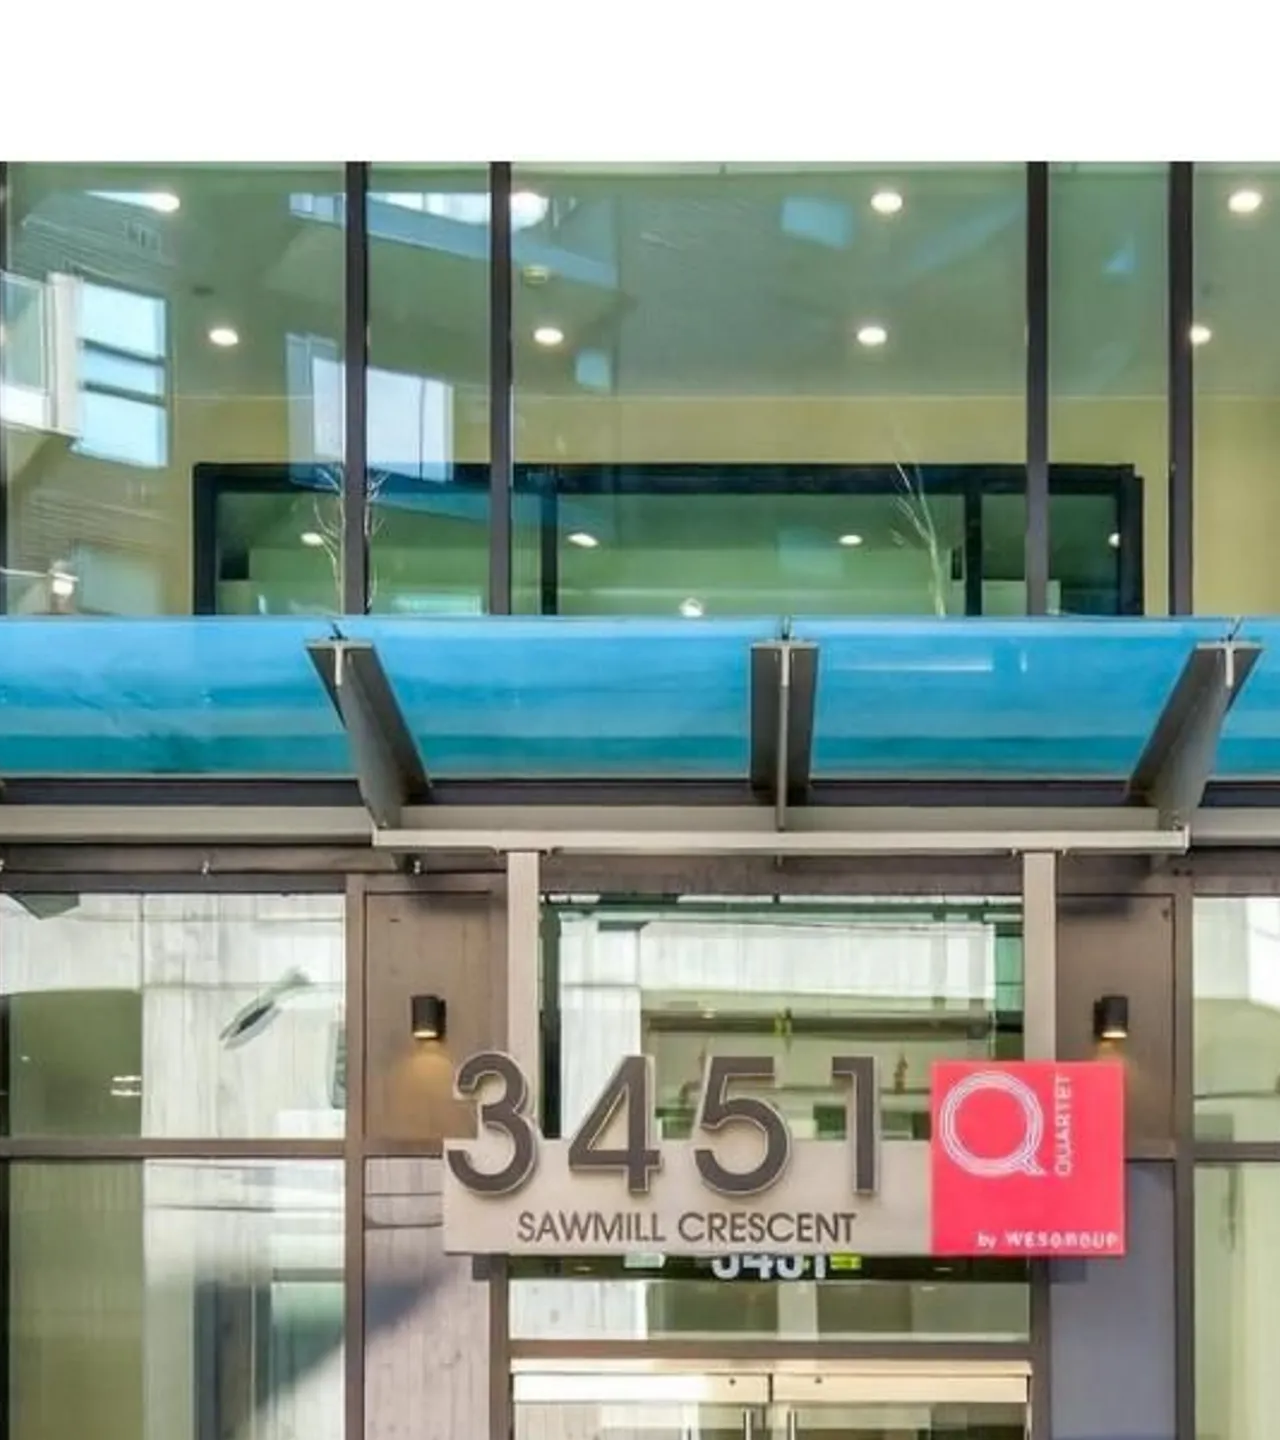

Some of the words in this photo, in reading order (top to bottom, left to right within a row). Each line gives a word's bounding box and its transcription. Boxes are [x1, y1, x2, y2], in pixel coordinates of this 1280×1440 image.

[447, 1052, 878, 1194] 3451
[940, 1071, 1046, 1178] Q
[1055, 1075, 1071, 1177] QUARTET
[517, 1211, 666, 1243] SAWMILL
[677, 1211, 857, 1243] CRESCENT
[977, 1231, 997, 1249] by
